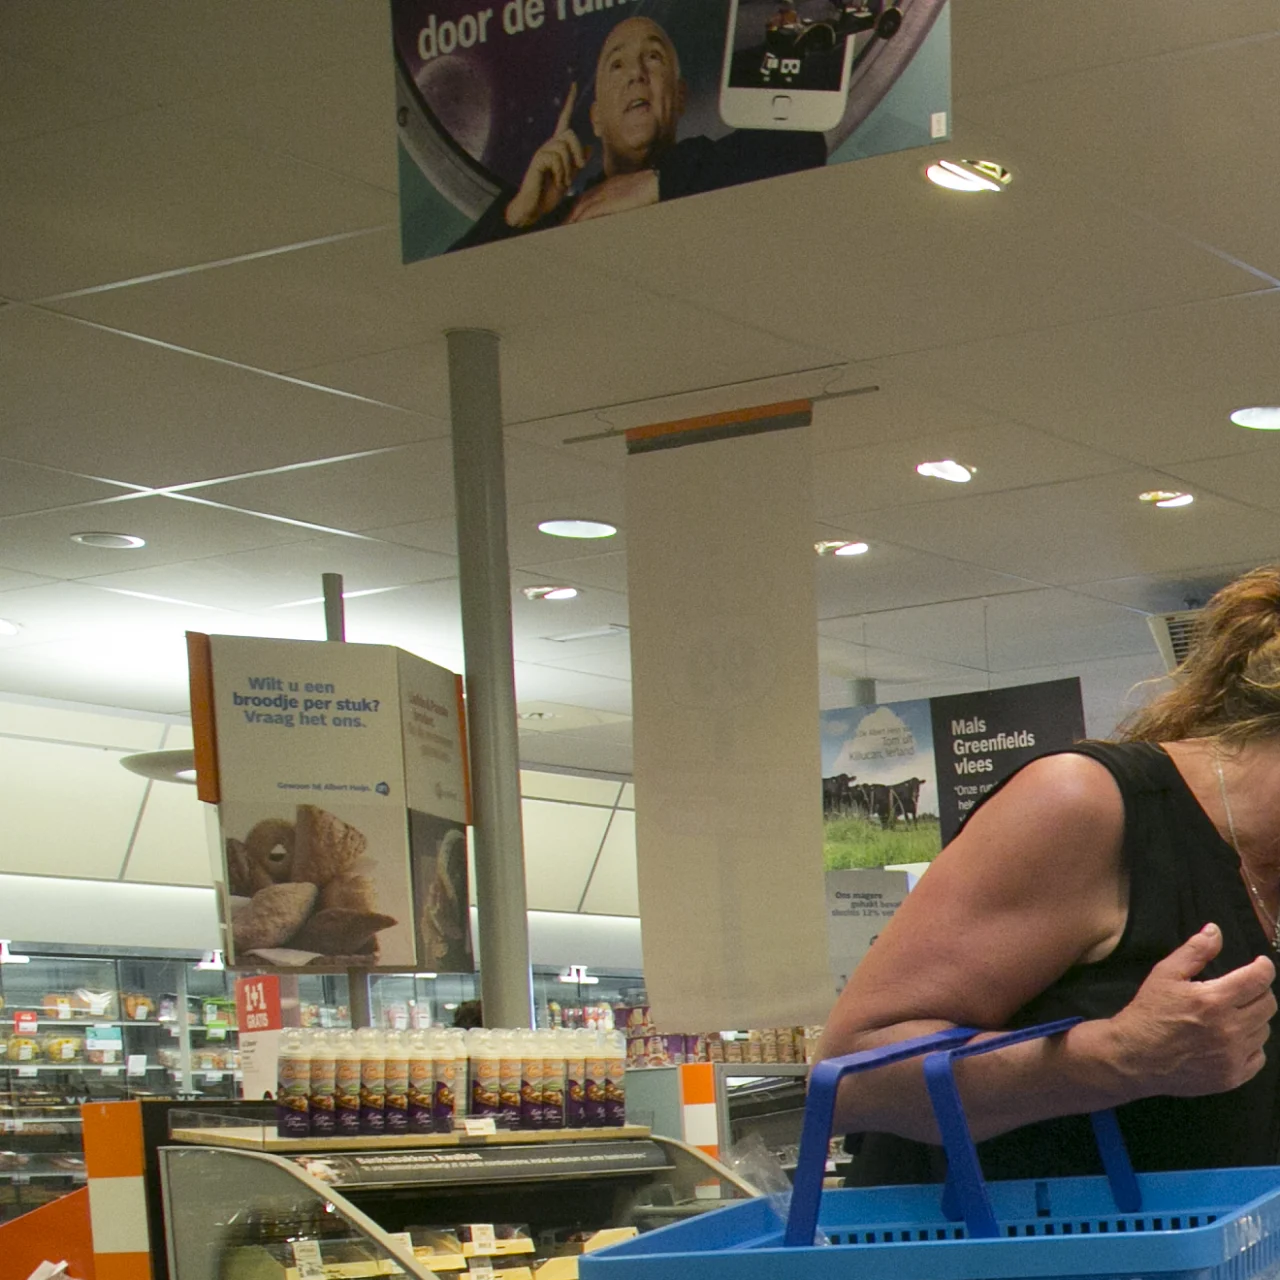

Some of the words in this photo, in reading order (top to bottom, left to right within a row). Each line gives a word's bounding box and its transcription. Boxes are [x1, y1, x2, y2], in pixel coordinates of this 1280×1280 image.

[418, 8, 493, 60] door
[503, 0, 545, 35] de
[249, 677, 283, 692] Wilt
[288, 680, 299, 692] u
[304, 681, 335, 694] een
[232, 692, 299, 711] broodje
[303, 698, 332, 712] per
[336, 698, 380, 712] stuk?
[244, 710, 295, 728] Vraag
[299, 711, 327, 727] het
[332, 715, 367, 728] ons.
[951, 716, 987, 736] Mals
[953, 730, 1036, 755] Greenfields
[954, 757, 994, 775] vlees
[244, 982, 267, 1011] 1+1
[246, 1013, 269, 1028] GRATIS
